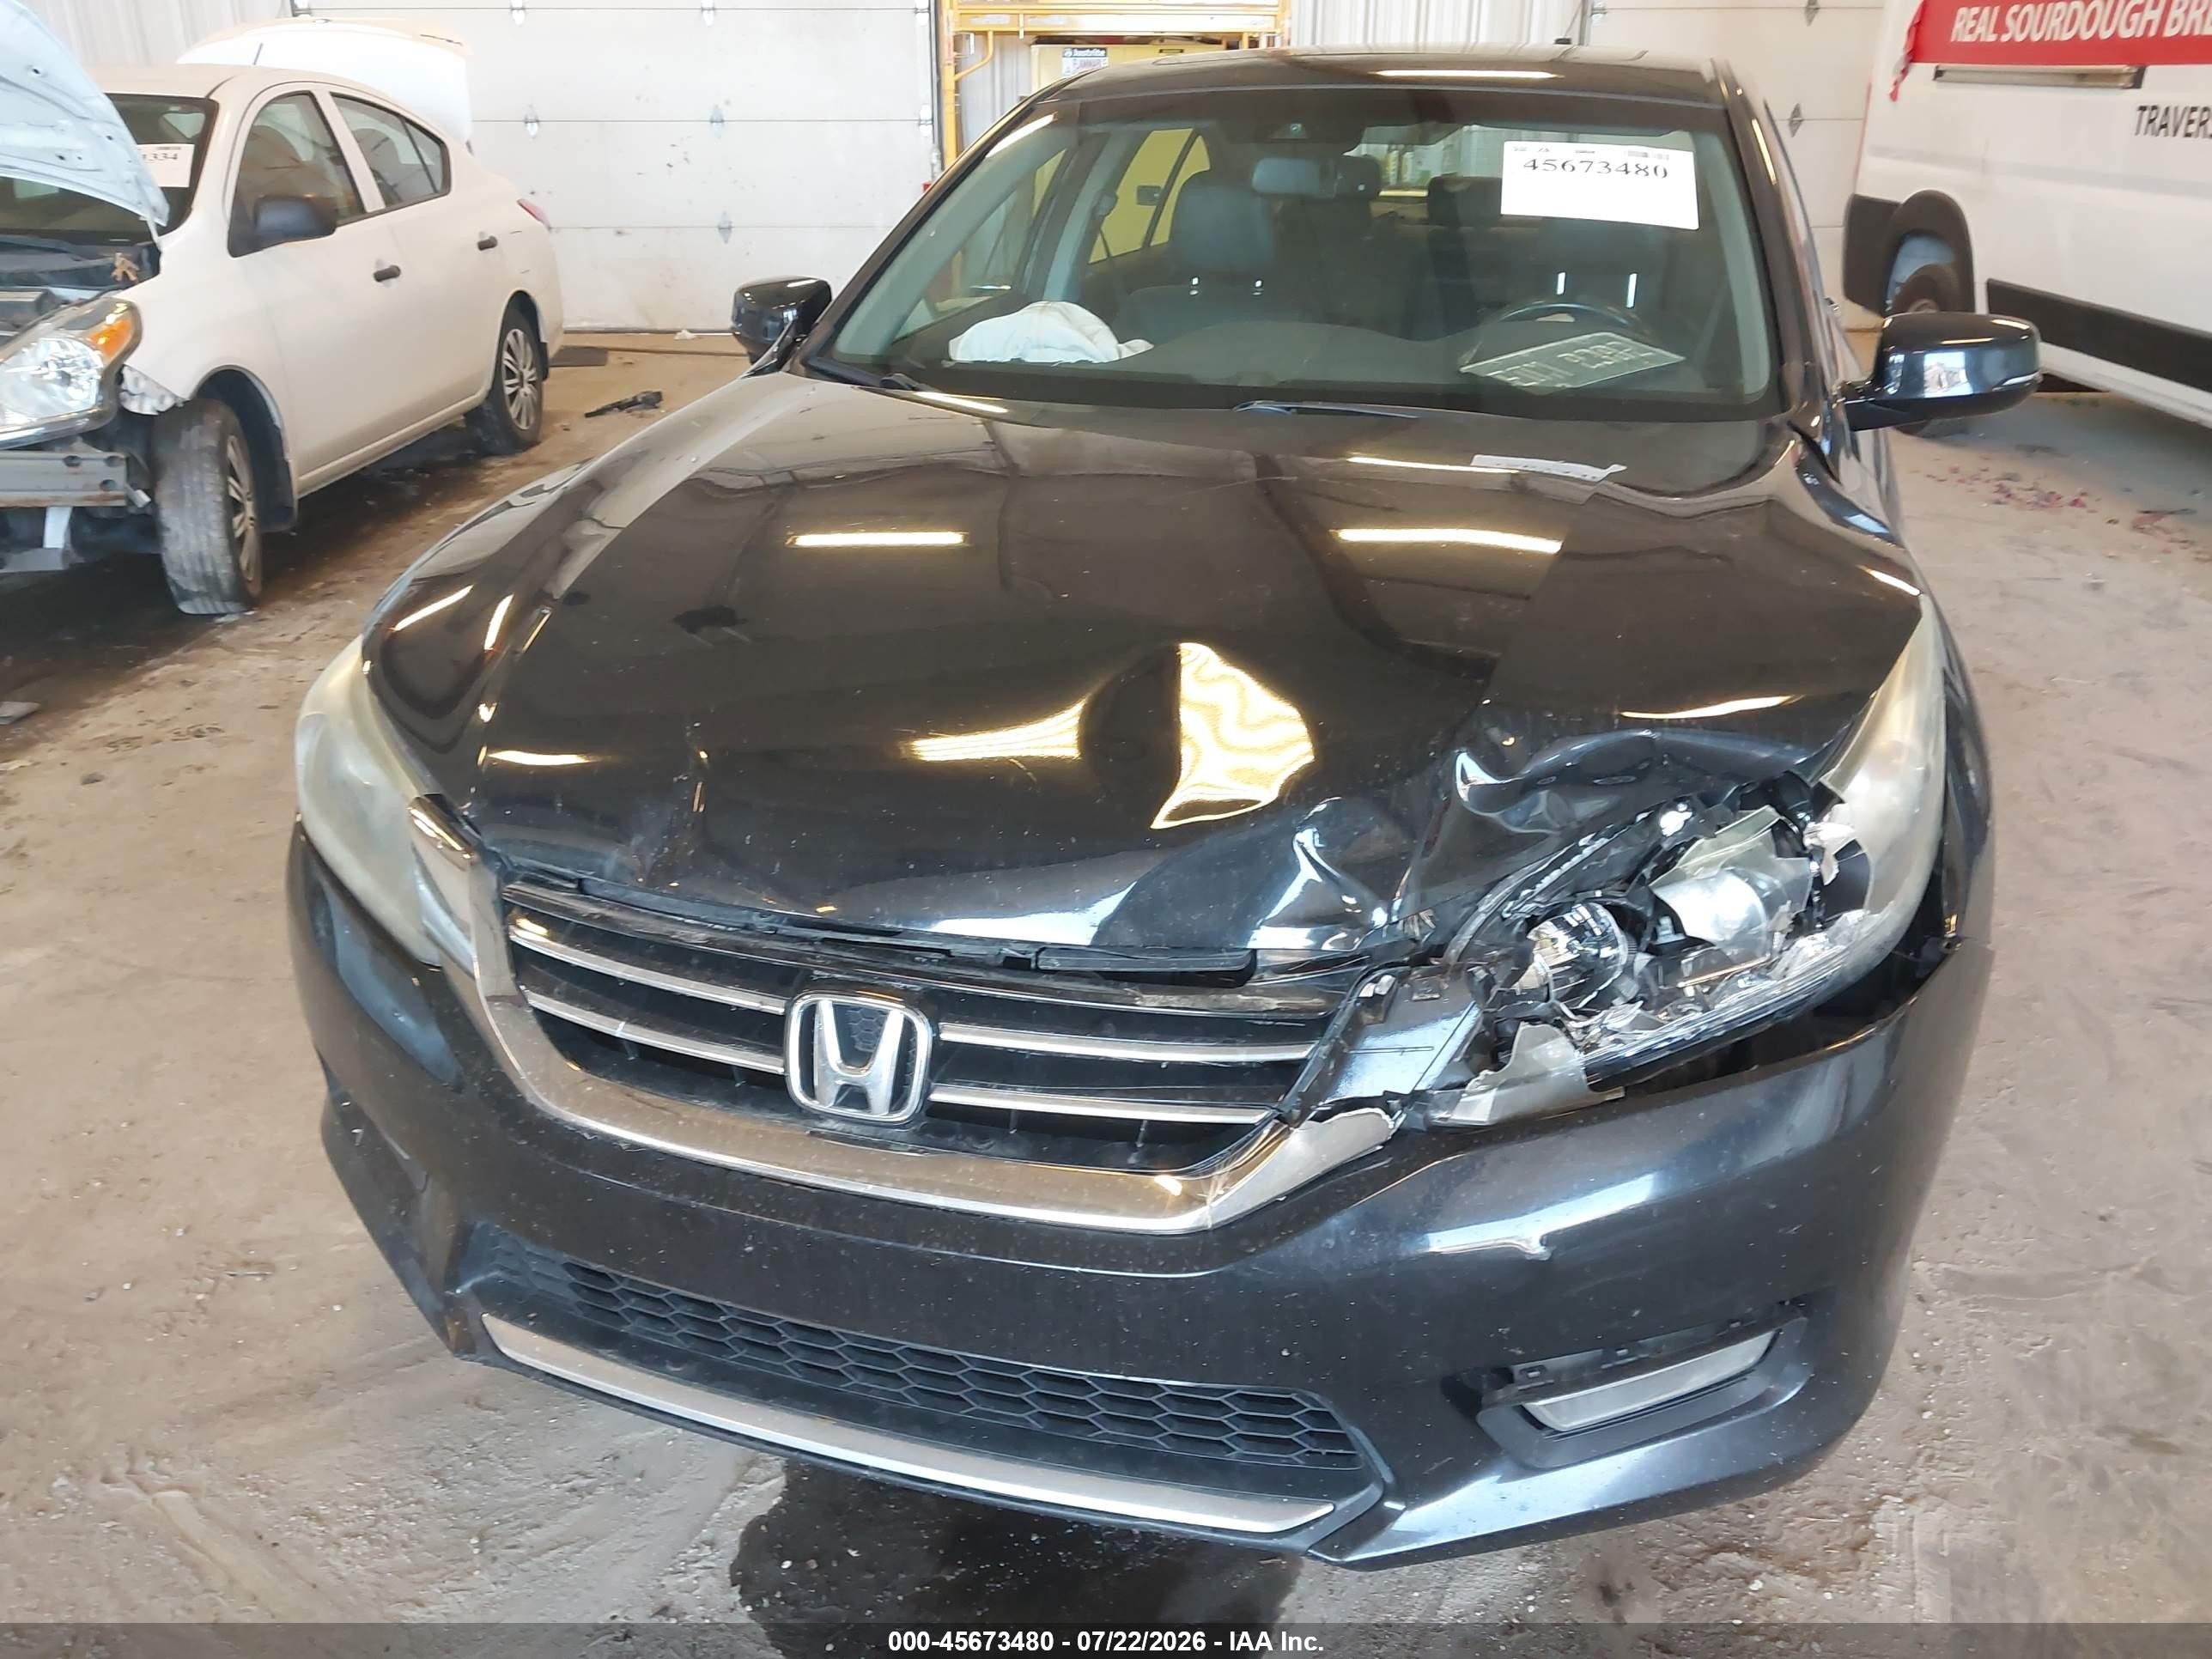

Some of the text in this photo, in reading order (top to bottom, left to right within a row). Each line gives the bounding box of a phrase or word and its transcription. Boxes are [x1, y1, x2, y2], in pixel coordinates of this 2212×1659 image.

[1950, 5, 2001, 42] REAL
[2000, 0, 2168, 42] SOURDOUGH
[2134, 105, 2212, 138] TRAVER
[1523, 158, 1668, 179] 45673480
